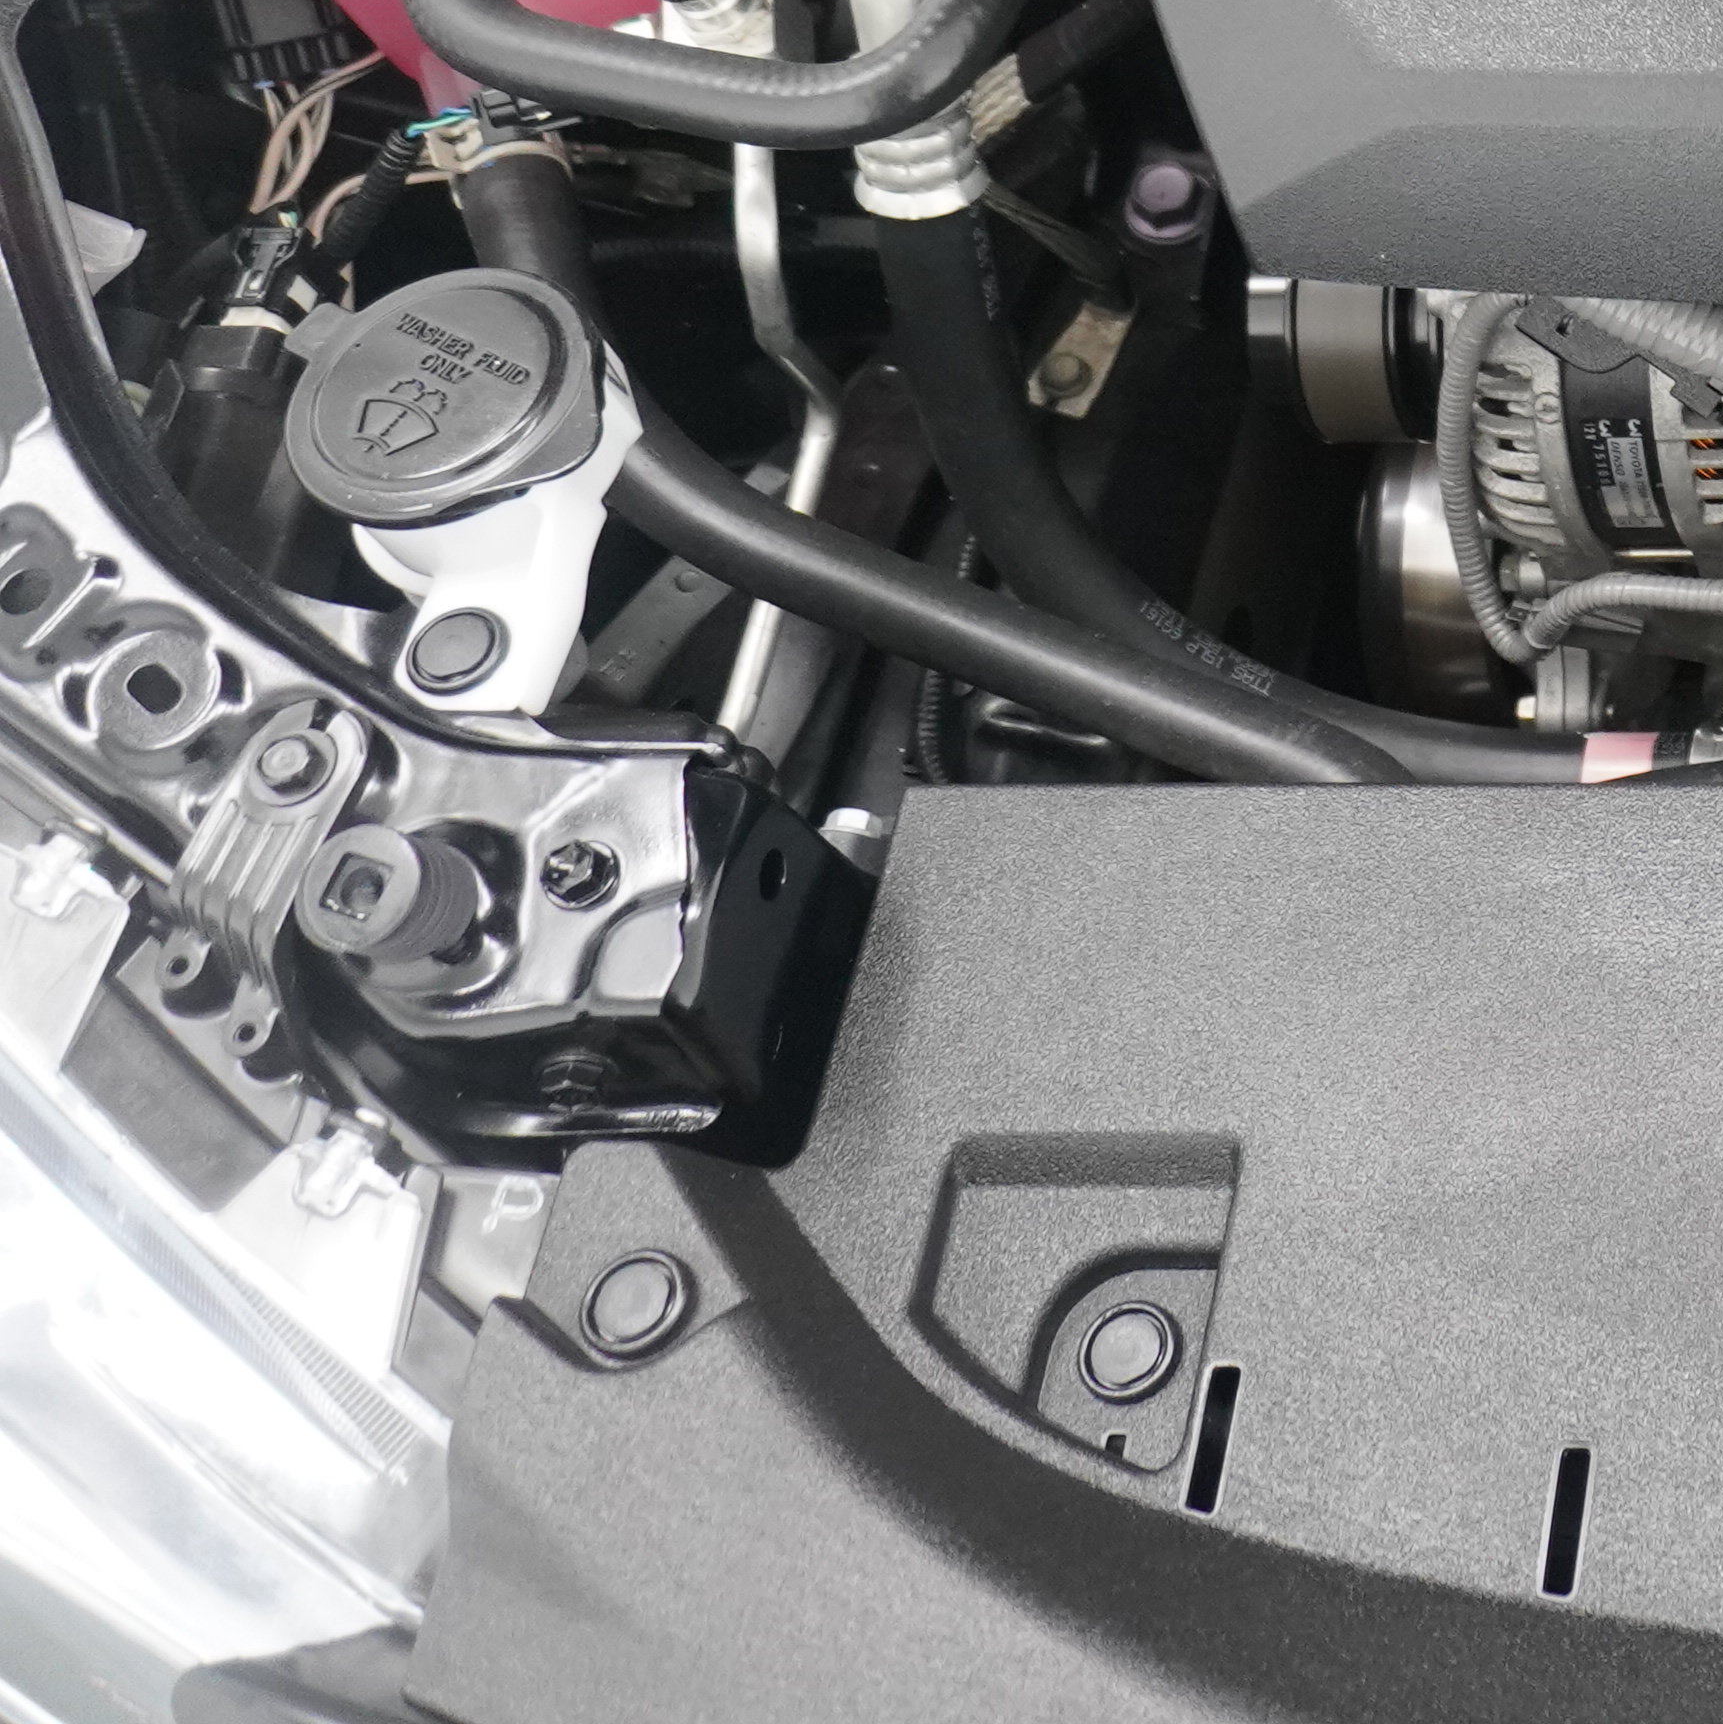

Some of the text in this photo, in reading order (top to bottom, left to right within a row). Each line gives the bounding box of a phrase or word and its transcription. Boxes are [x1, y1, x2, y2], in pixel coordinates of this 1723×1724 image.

[395, 312, 531, 387] WASHER FLUID
[419, 354, 473, 385] ONLY
[1610, 441, 1626, 477] DENSO
[1628, 440, 1643, 477] TOYOTA
